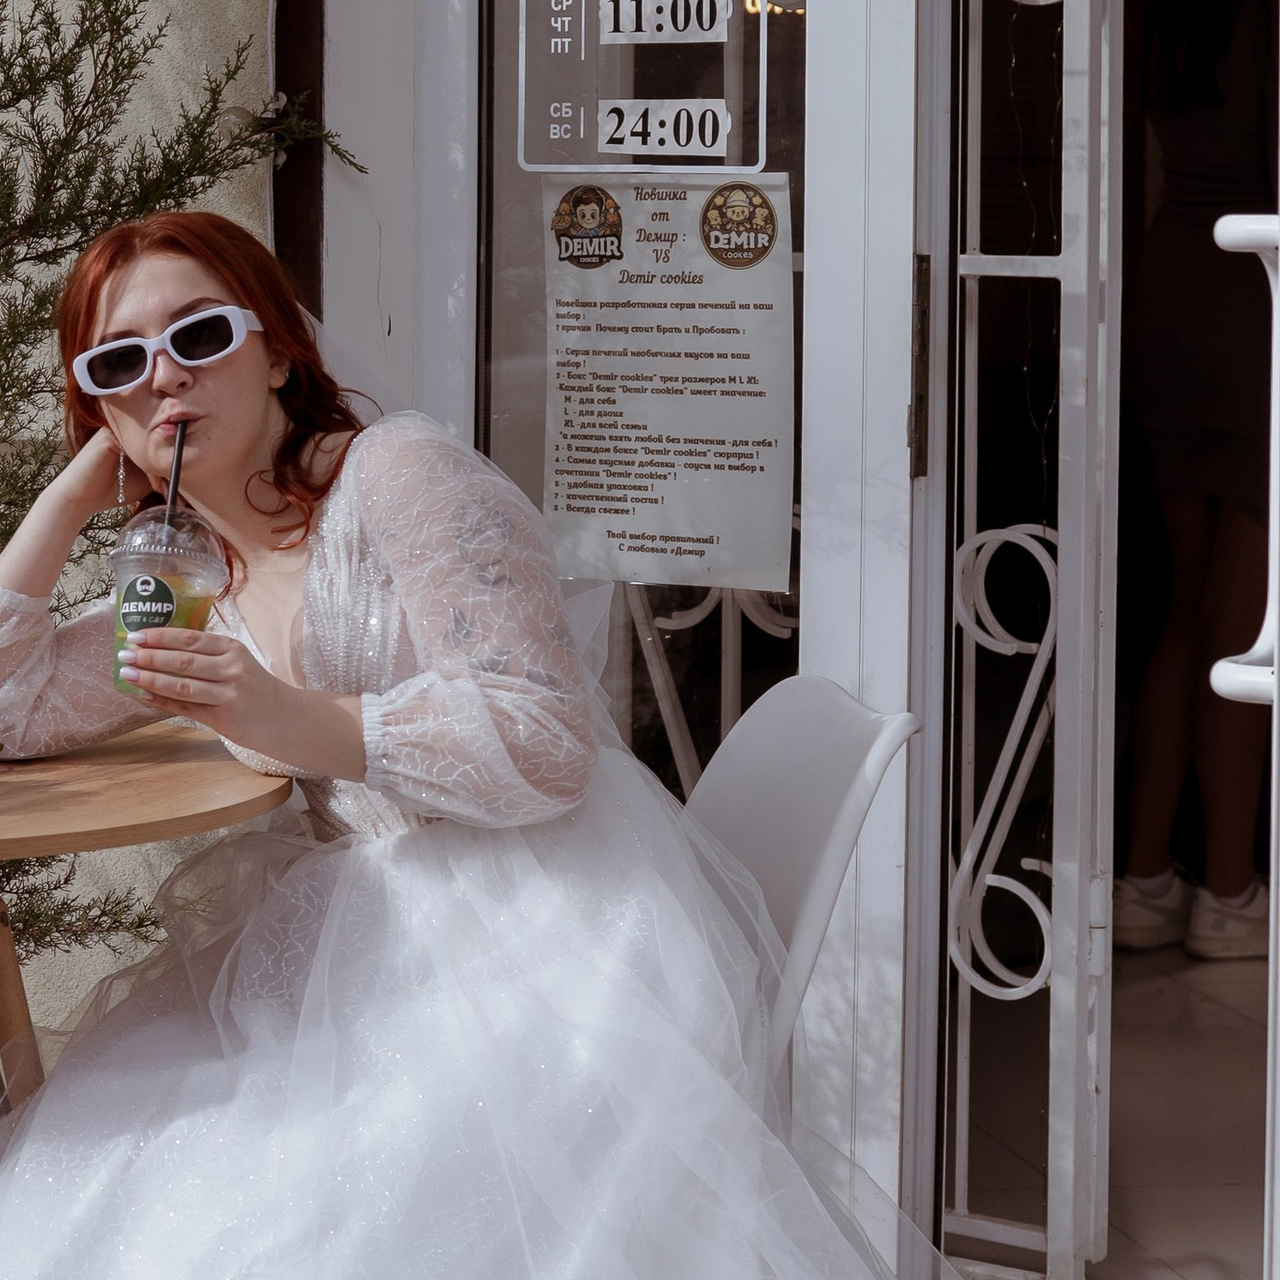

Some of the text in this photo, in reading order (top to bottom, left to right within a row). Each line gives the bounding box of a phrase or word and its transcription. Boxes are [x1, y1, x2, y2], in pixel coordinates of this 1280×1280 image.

[551, 17, 572, 32] ЧТ
[551, 38, 572, 53] ПТ
[550, 103, 572, 118] СБ
[550, 124, 571, 139] ВС
[605, 107, 720, 148] 24:00
[634, 187, 687, 201] Новинка
[652, 212, 670, 222] от
[636, 229, 679, 249] Демир
[709, 230, 769, 249] DEMIR
[560, 236, 620, 258] DEMIR
[653, 249, 670, 263] VS
[619, 270, 704, 285] Demir cookies
[556, 299, 597, 307] Новейшая
[600, 300, 667, 309] разработанная
[670, 302, 695, 311] серия
[699, 301, 736, 309] печений
[556, 312, 581, 321] выбор
[596, 324, 628, 334] Почему
[657, 325, 682, 335] Брать
[693, 326, 740, 335] Пробовать
[566, 348, 589, 357] Серия
[592, 348, 628, 356] печений
[631, 349, 681, 358] необычных
[684, 351, 714, 360] вкусов
[556, 360, 581, 369] выбор
[682, 377, 726, 385] размеров
[596, 385, 616, 393] бокс
[579, 397, 594, 405] для
[599, 421, 618, 430] всей
[570, 433, 606, 441] можешь
[635, 434, 663, 443] любой
[666, 435, 680, 443] без
[683, 437, 725, 445] значения
[752, 439, 772, 447] себя
[613, 445, 638, 454] боксе
[714, 452, 753, 460] сюрприз
[567, 456, 596, 464] Самые
[599, 459, 635, 467] вкусные
[638, 460, 675, 468] добавки
[684, 463, 711, 471] соусы
[728, 463, 756, 473] выбор
[567, 481, 603, 489] удобная
[607, 484, 648, 492] упаковка
[567, 494, 628, 502] качественный
[631, 496, 658, 504] состав
[567, 504, 596, 513] Всегда
[599, 507, 630, 515] свежее
[607, 530, 714, 543] Твой выбор правильный
[627, 545, 667, 554] любовью
[121, 601, 173, 614] ДЕМИР
